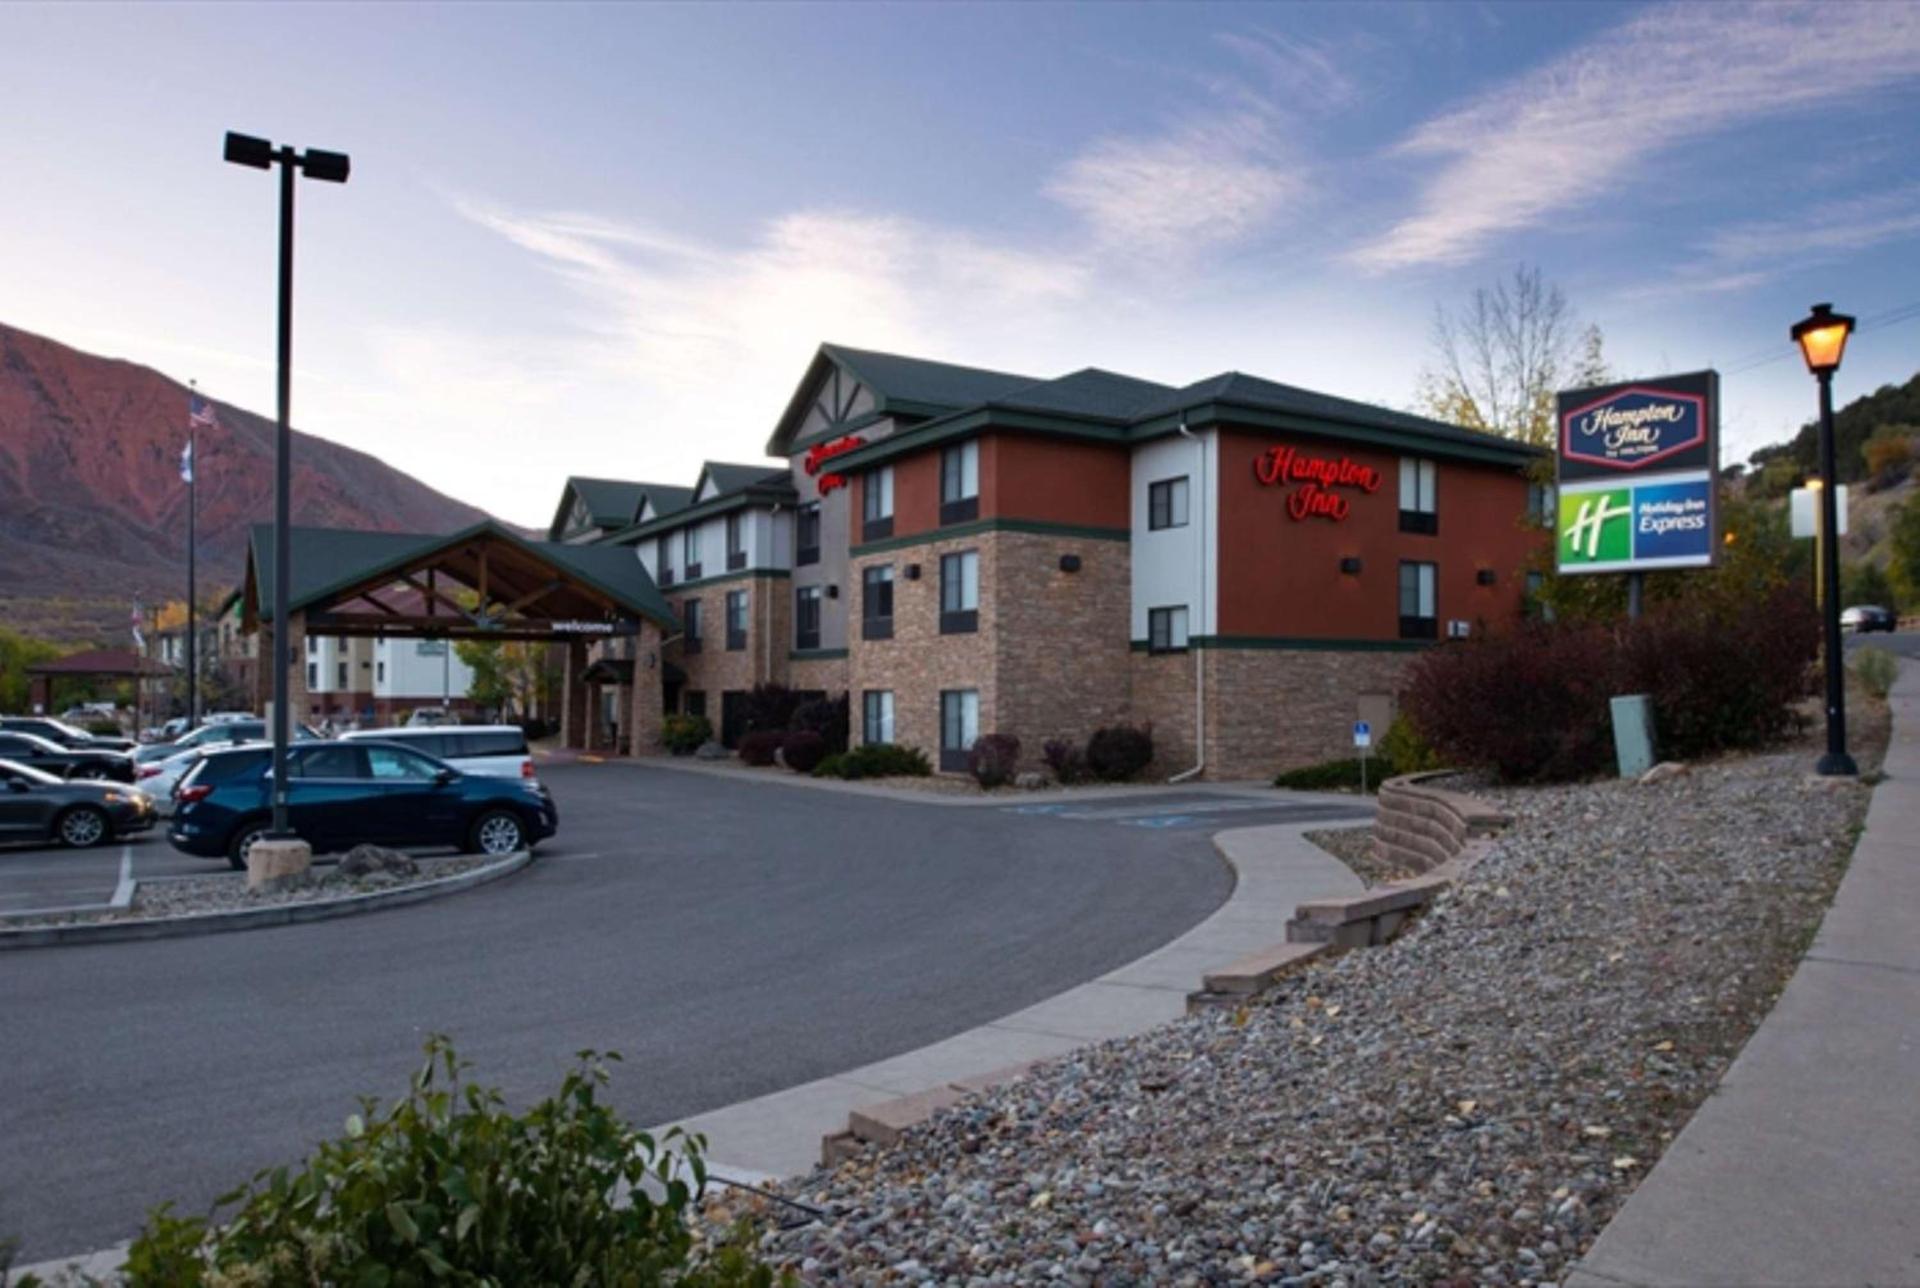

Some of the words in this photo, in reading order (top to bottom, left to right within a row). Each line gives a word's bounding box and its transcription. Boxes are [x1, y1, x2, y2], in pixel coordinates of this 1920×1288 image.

[1581, 404, 1684, 435] Hampton
[1604, 426, 1660, 448] Inn
[1254, 445, 1382, 493] Hampton
[1286, 482, 1351, 522] Inn
[1639, 515, 1706, 534] Express
